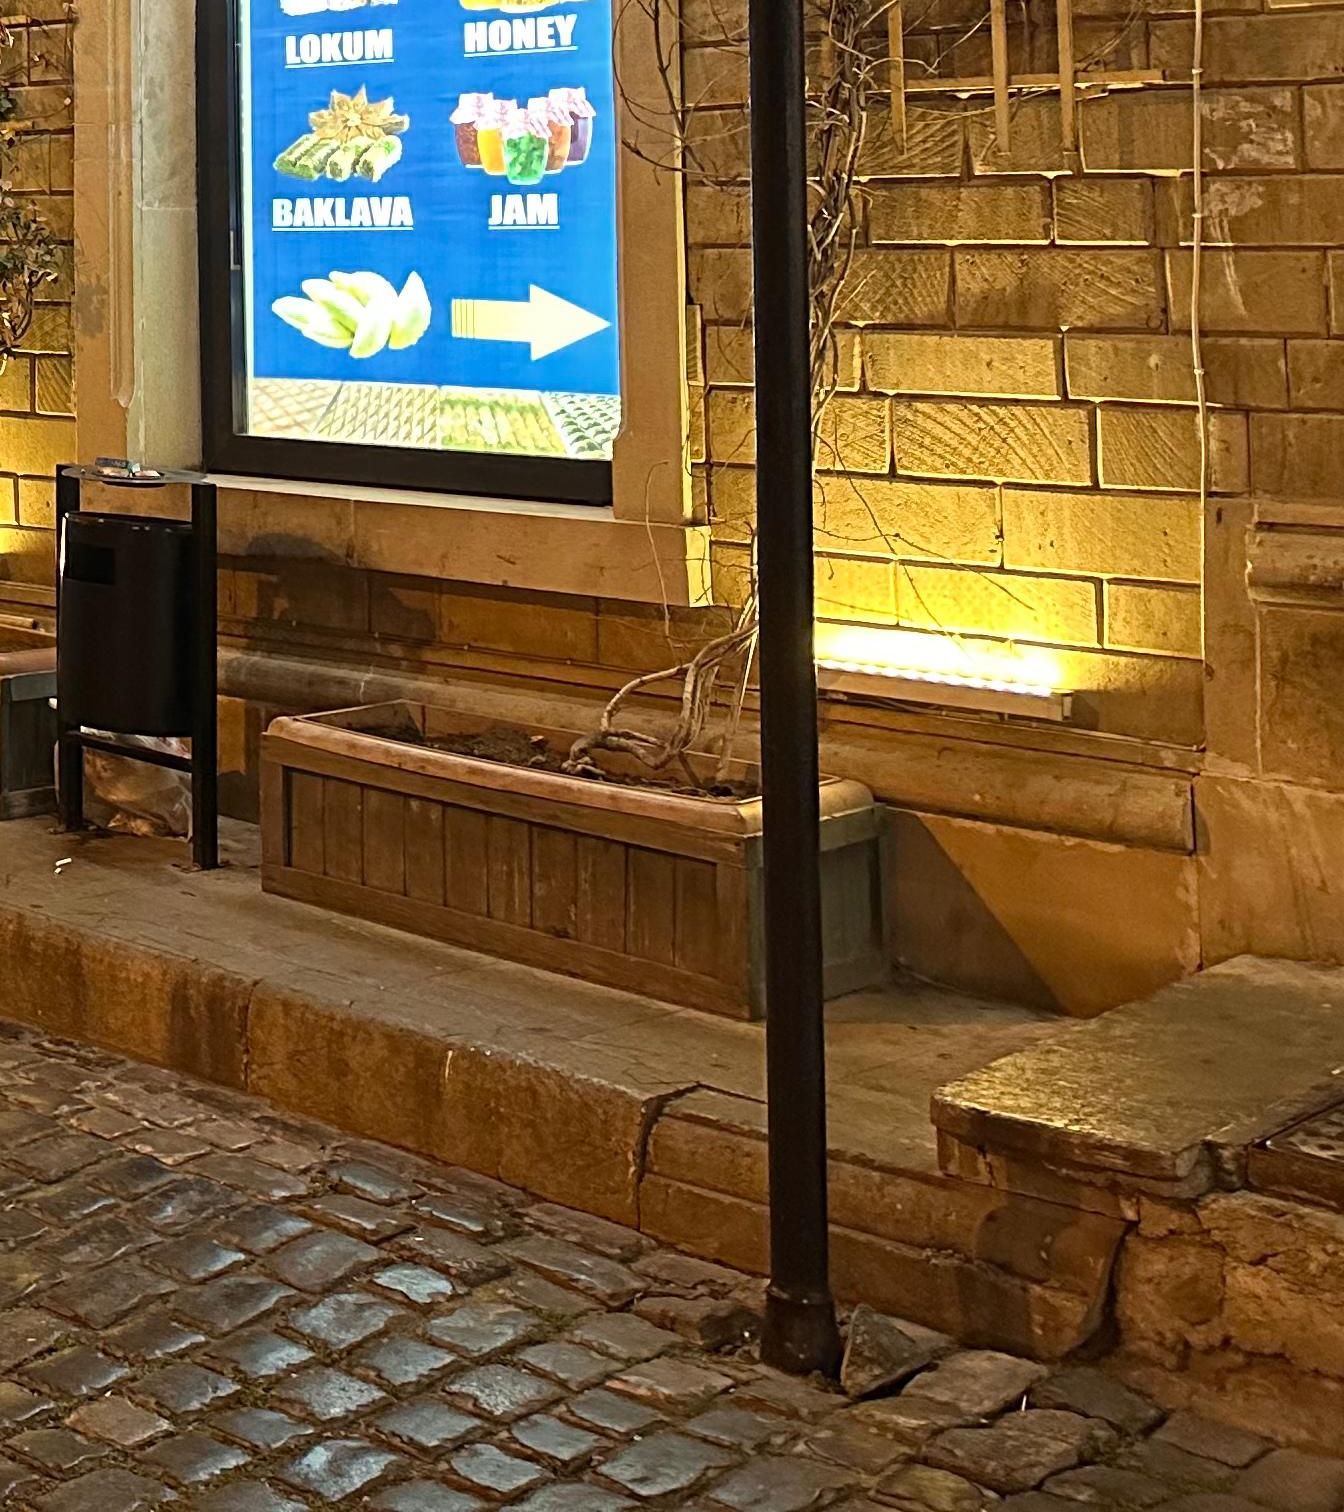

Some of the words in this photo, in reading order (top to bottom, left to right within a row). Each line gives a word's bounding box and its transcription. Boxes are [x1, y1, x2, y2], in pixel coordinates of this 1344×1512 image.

[285, 28, 394, 64] LOKUM
[464, 14, 578, 51] HONEY
[272, 194, 414, 228] BAKLAVA
[488, 193, 560, 226] JAM
